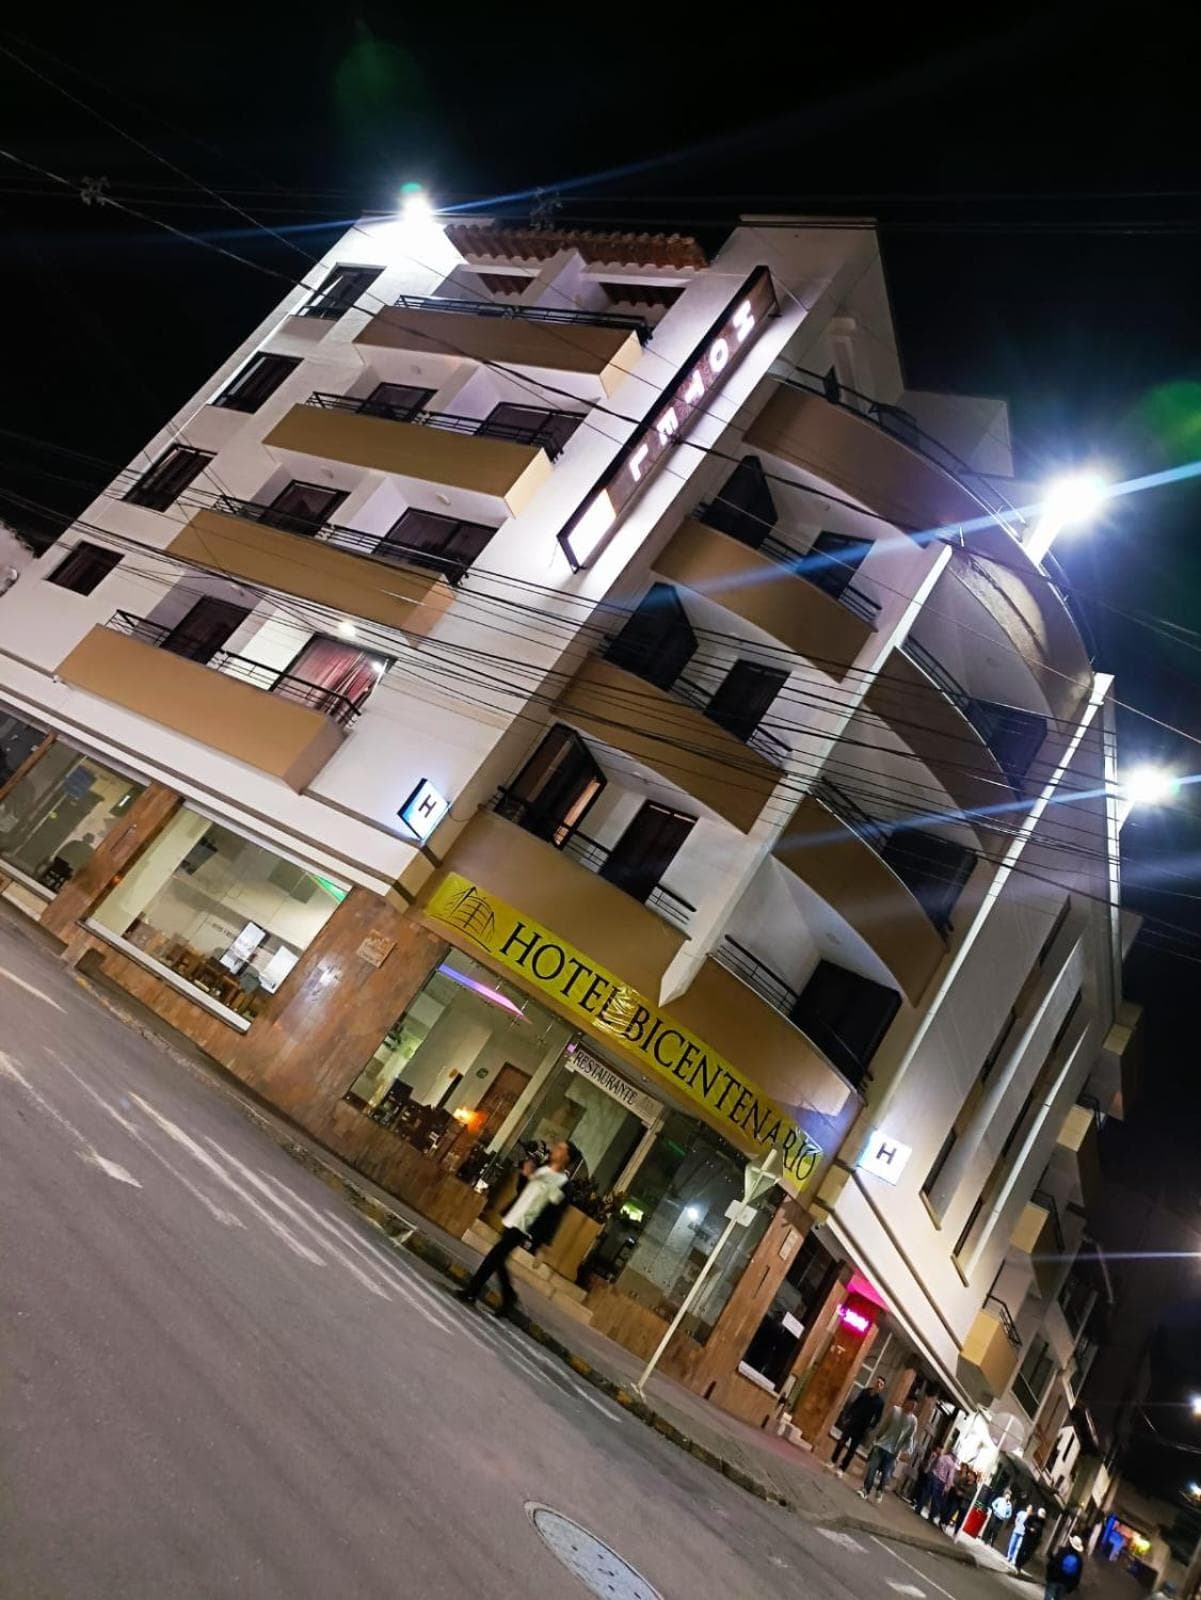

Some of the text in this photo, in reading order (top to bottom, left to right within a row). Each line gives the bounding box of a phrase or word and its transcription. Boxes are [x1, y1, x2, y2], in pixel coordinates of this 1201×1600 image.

[628, 300, 755, 482] HOTEL
[418, 793, 438, 818] H
[499, 921, 818, 1181] HOTEL BICENTENARIO
[573, 1050, 639, 1106] RESTAURANTE
[875, 1142, 898, 1166] H
